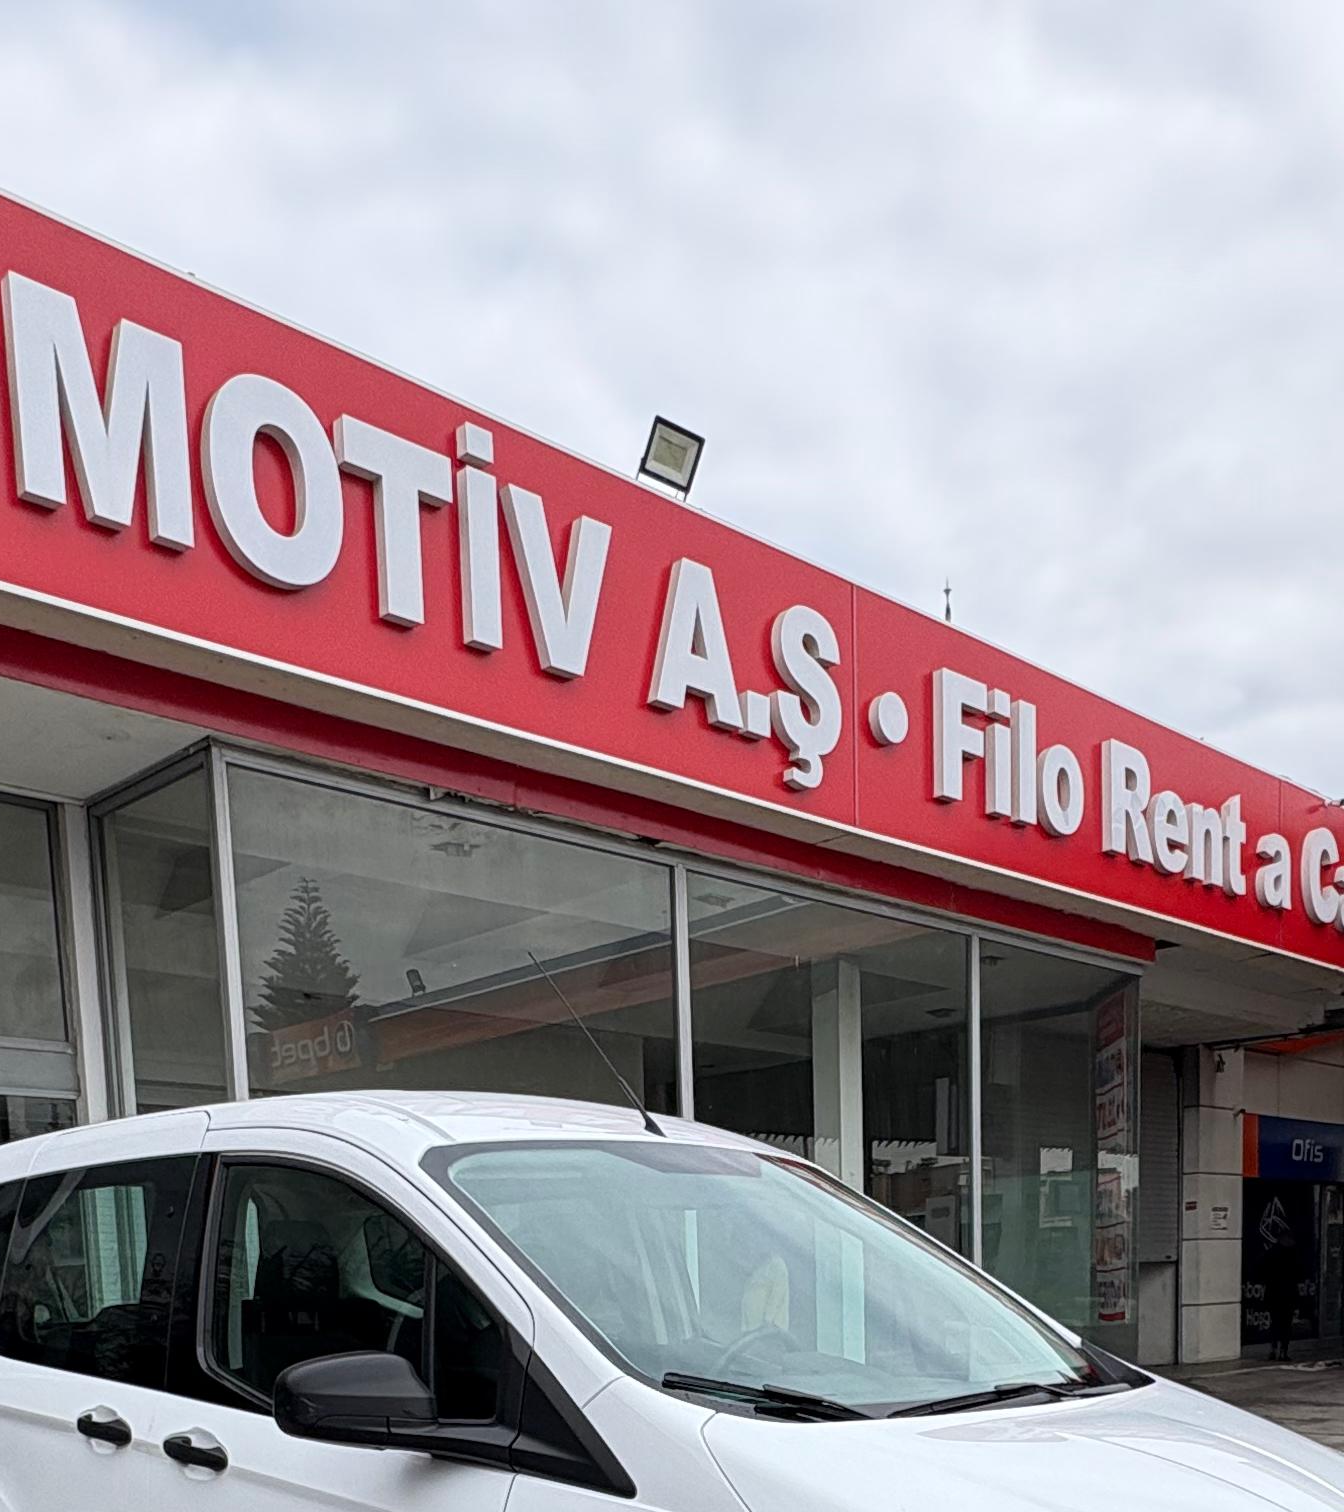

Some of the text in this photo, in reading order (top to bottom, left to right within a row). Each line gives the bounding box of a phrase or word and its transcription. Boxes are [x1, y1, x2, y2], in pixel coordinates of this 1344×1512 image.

[932, 667, 1084, 836] Filo
[1101, 738, 1247, 896] Rent
[1256, 833, 1292, 910] a
[1292, 1139, 1324, 1163] Ofis
